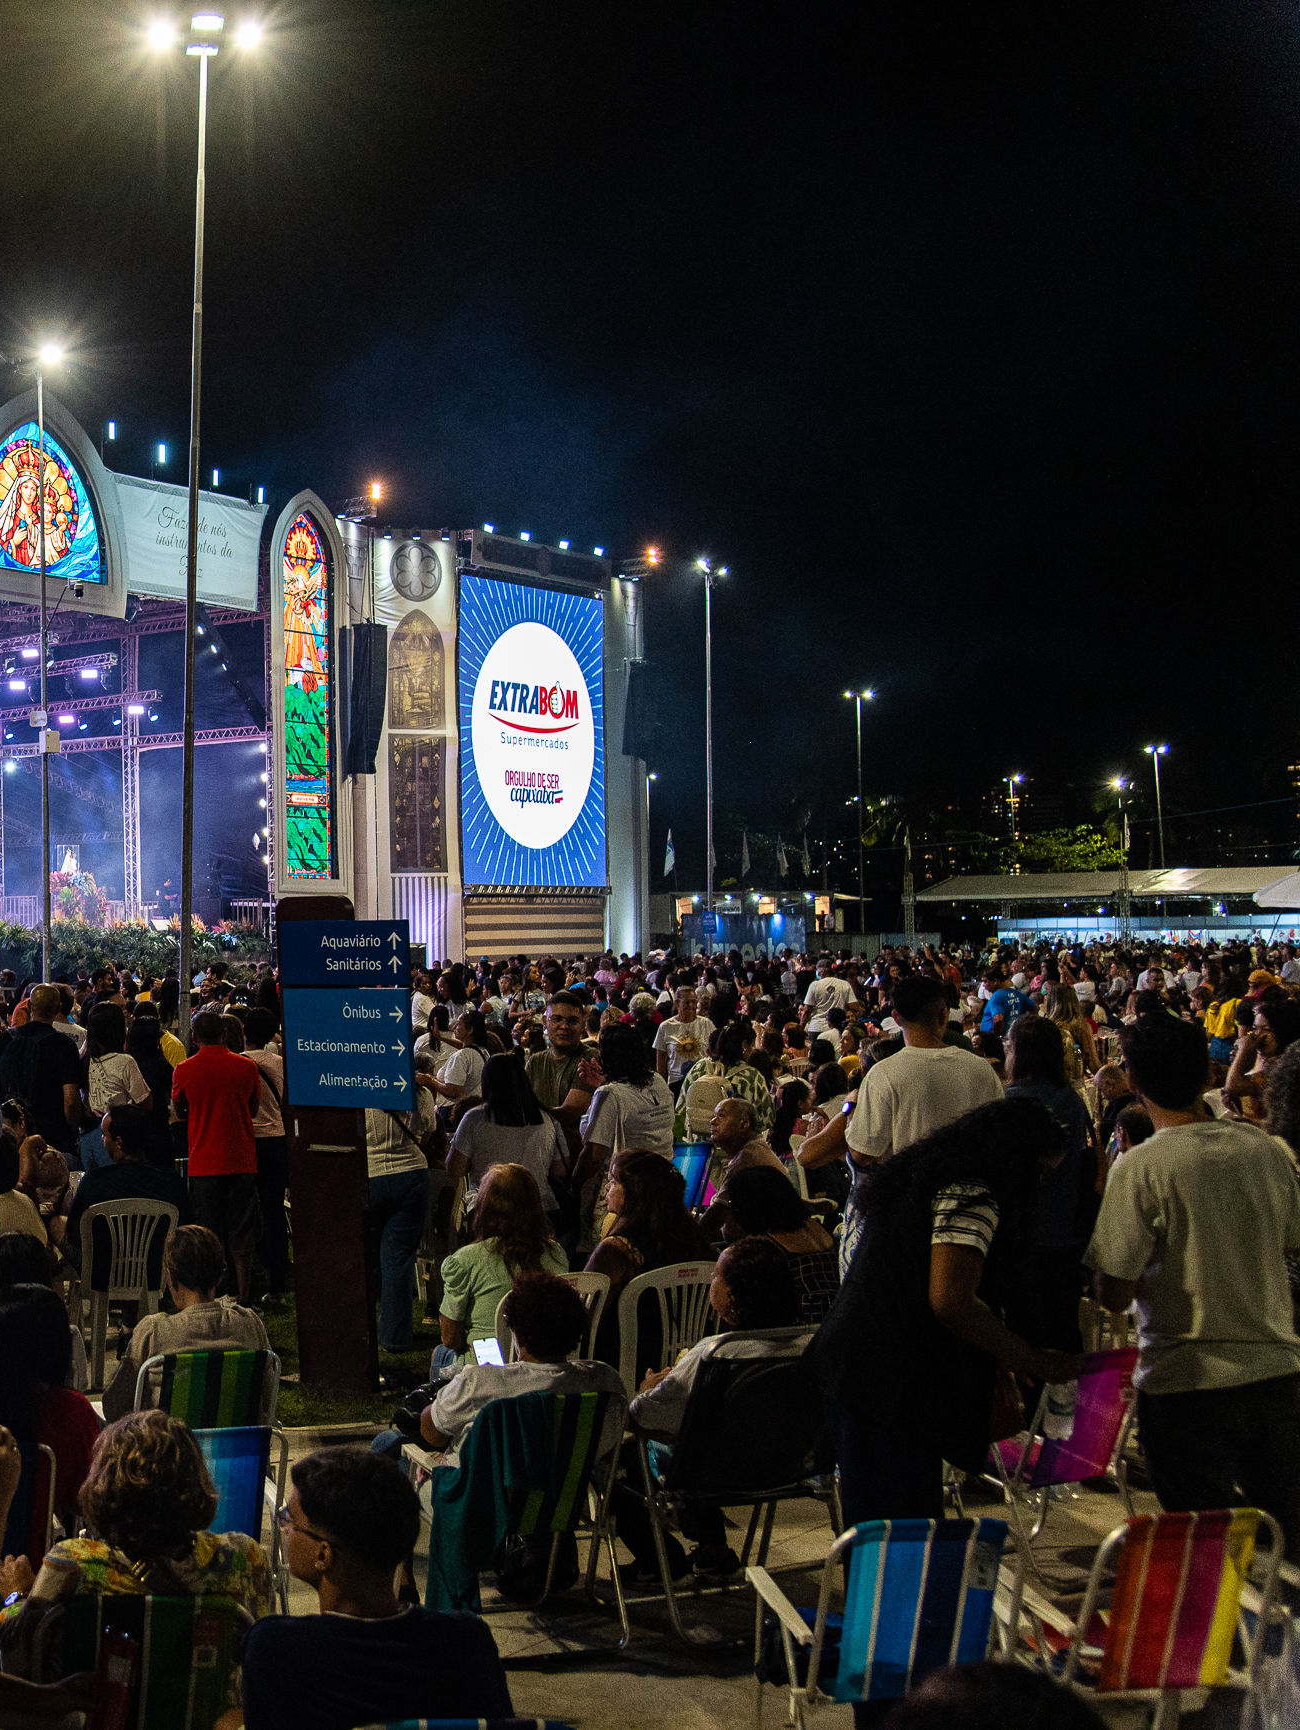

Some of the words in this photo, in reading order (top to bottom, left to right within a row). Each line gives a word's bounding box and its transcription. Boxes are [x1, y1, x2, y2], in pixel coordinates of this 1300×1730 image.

[158, 506, 189, 530] Faz
[198, 516, 208, 534] de
[210, 524, 227, 538] nós
[220, 542, 232, 558] da
[488, 680, 579, 720] EXTRABOM
[500, 731, 569, 750] Supermercados
[504, 769, 536, 788] ORGULHO
[537, 772, 546, 788] DE
[546, 773, 560, 790] SER
[510, 785, 555, 808] capixaba
[320, 934, 380, 950] Aquaviário
[326, 957, 382, 970] Sanitários
[342, 1002, 381, 1018] Ônibus
[297, 1038, 386, 1054] Estacionamento
[319, 1072, 388, 1090] Alimentação
